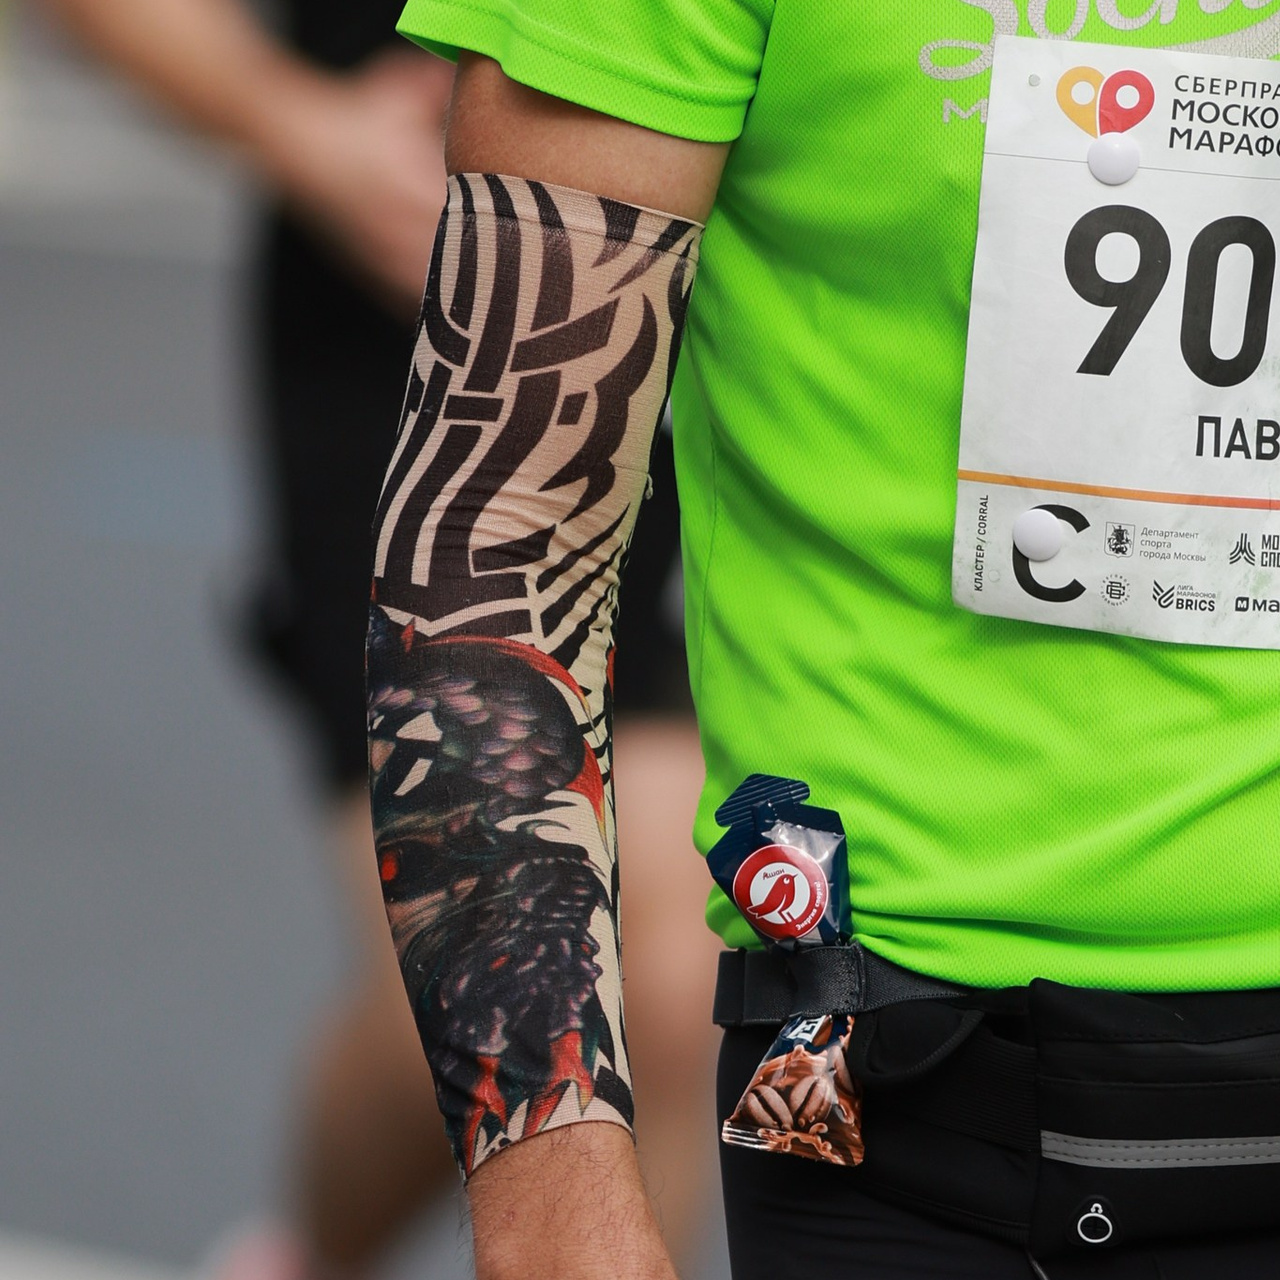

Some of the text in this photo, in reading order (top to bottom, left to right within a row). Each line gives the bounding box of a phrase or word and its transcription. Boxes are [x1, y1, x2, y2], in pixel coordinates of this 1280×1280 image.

[977, 495, 989, 536] CORRAL
[1140, 527, 1199, 540] Департамент
[1140, 540, 1172, 550] спорта
[1139, 550, 1207, 562] города Москвы
[974, 544, 985, 592] КЛАСТЕР
[1176, 591, 1216, 599] МАРАФОНОВ
[1175, 598, 1216, 612] BRICS
[795, 908, 818, 931] Энергия
